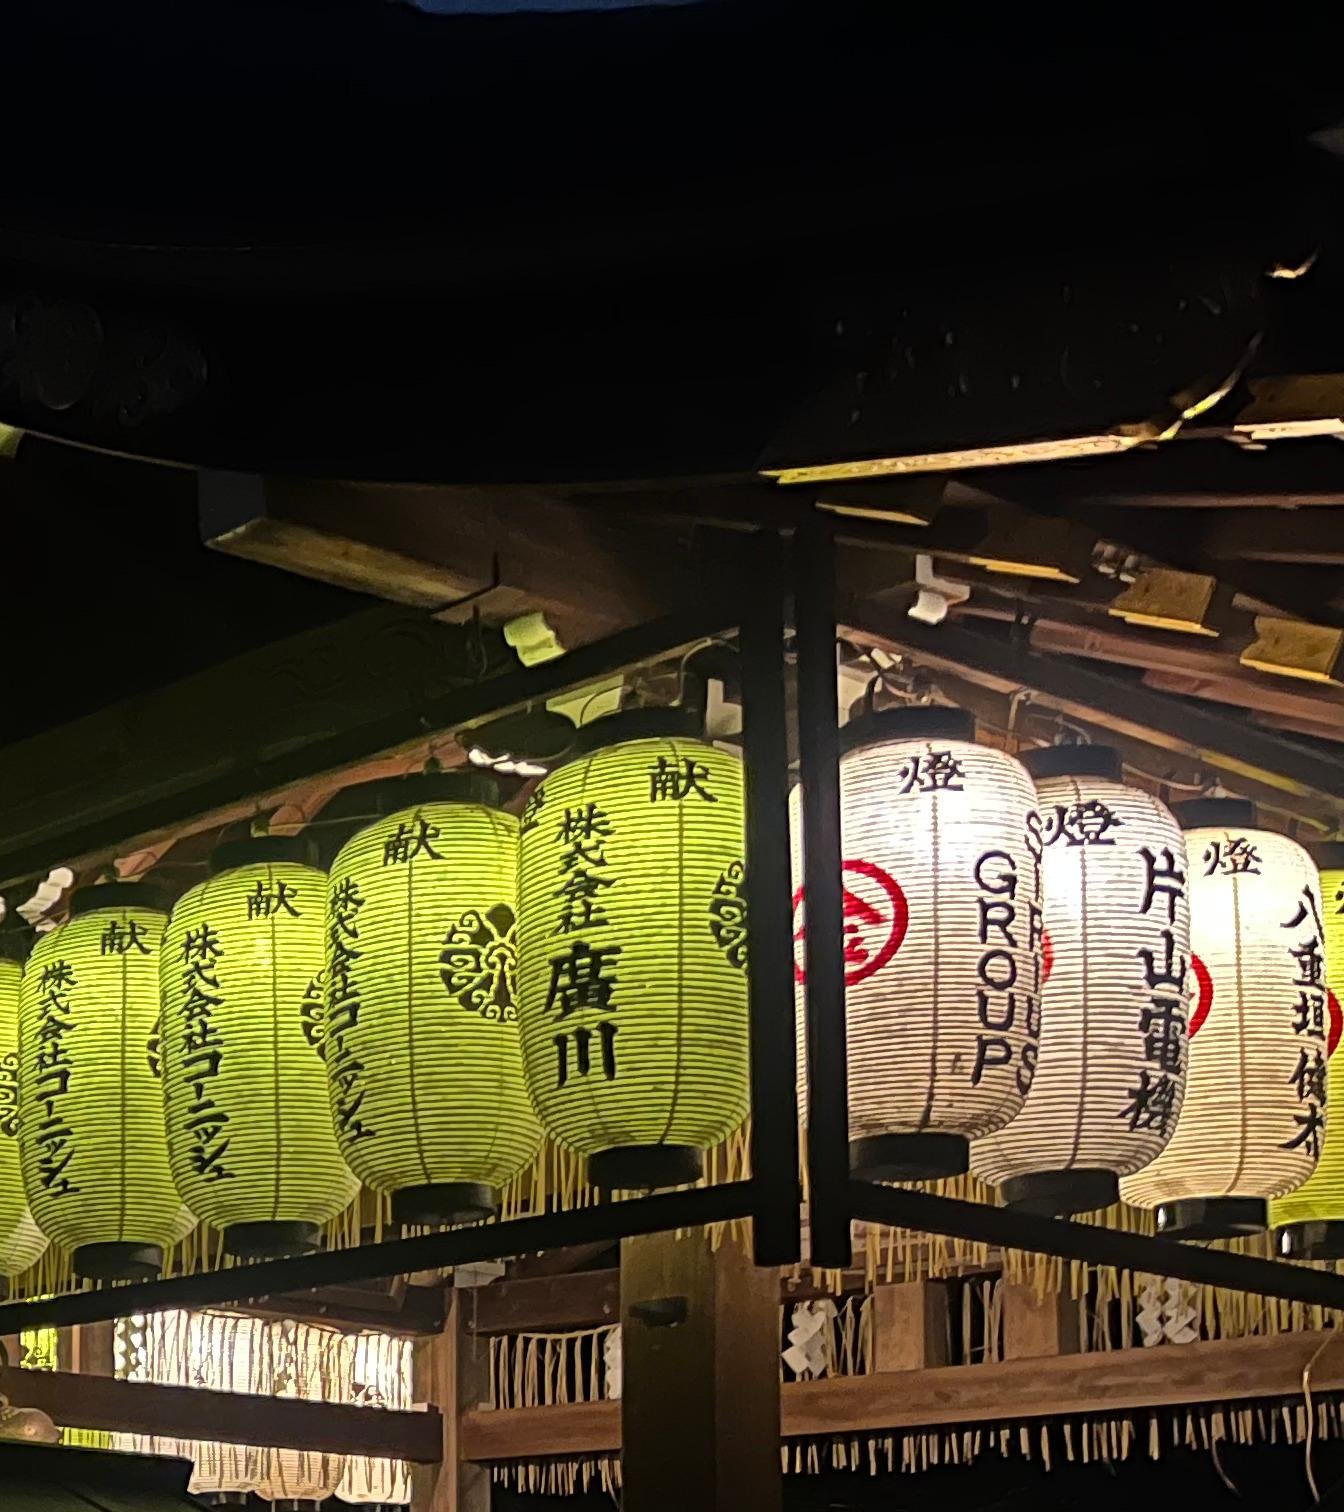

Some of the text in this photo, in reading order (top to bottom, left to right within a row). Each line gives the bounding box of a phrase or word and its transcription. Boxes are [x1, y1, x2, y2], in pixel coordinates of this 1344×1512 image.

[648, 756, 720, 805] 献
[898, 750, 966, 795] 燈
[381, 819, 446, 867] 献
[1044, 799, 1123, 849] 燈
[1202, 836, 1263, 878] 燈
[246, 880, 302, 920] 献
[100, 920, 152, 956] 献
[971, 848, 1018, 1088] GROUP
